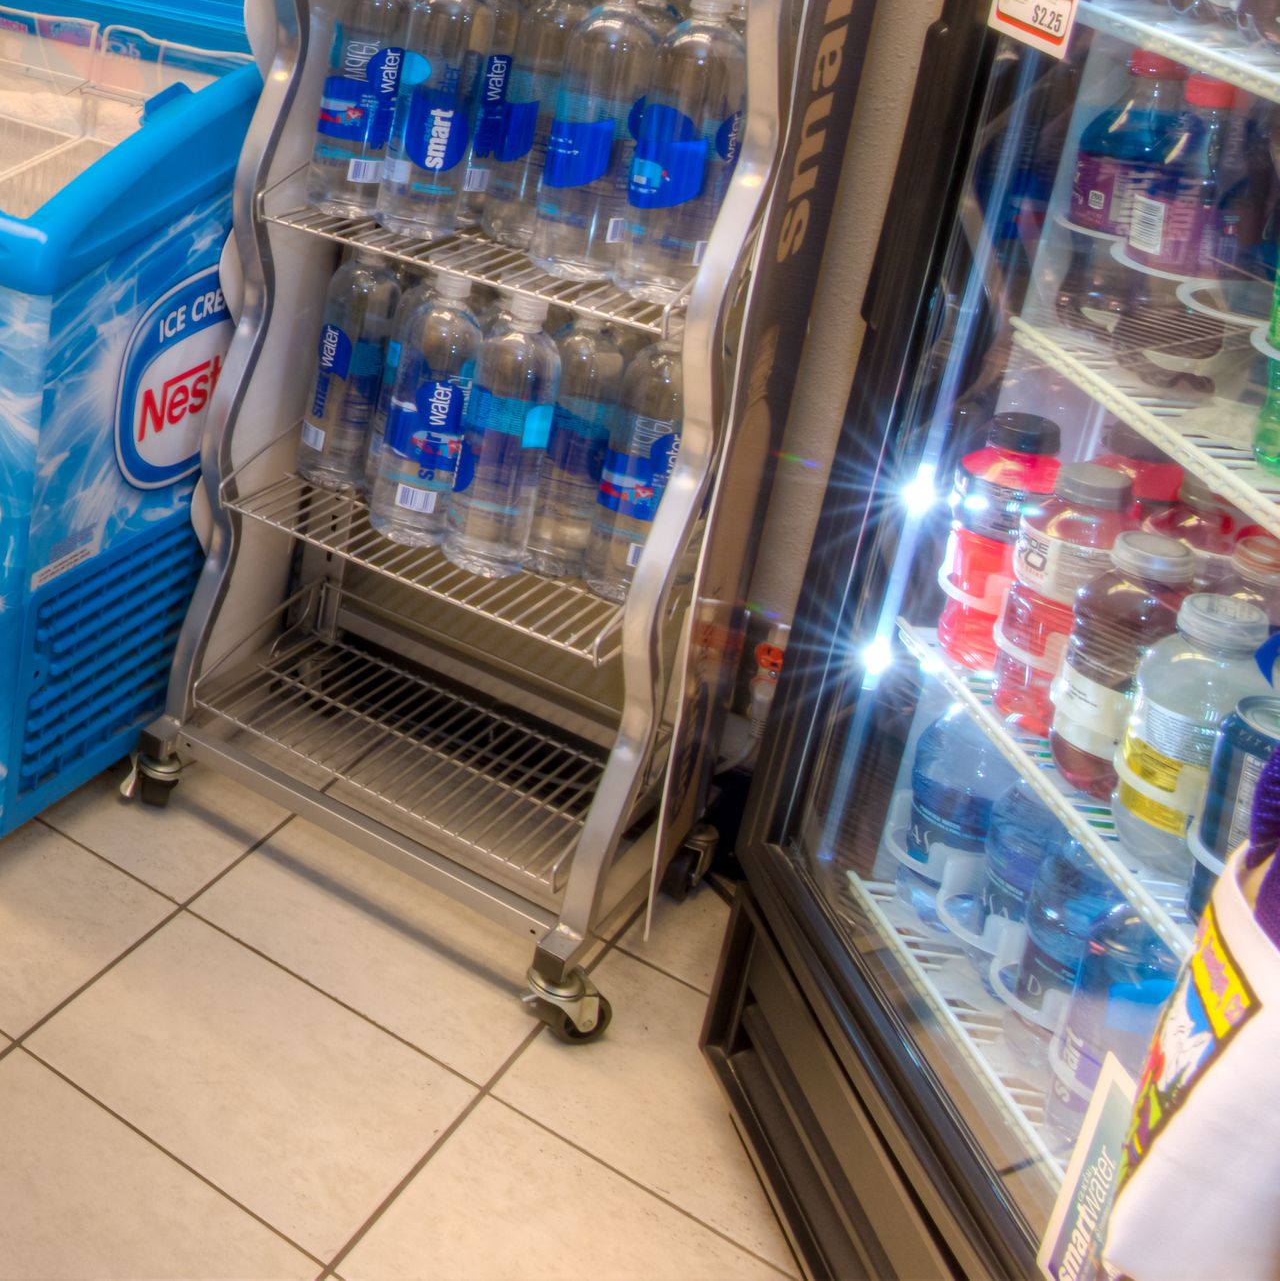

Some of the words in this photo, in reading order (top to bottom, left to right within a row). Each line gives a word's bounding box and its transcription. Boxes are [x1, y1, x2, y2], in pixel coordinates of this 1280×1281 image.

[1032, 4, 1063, 33] $2.25
[159, 305, 187, 343] ICE
[192, 288, 226, 321] CRE
[138, 356, 222, 442] Nest
